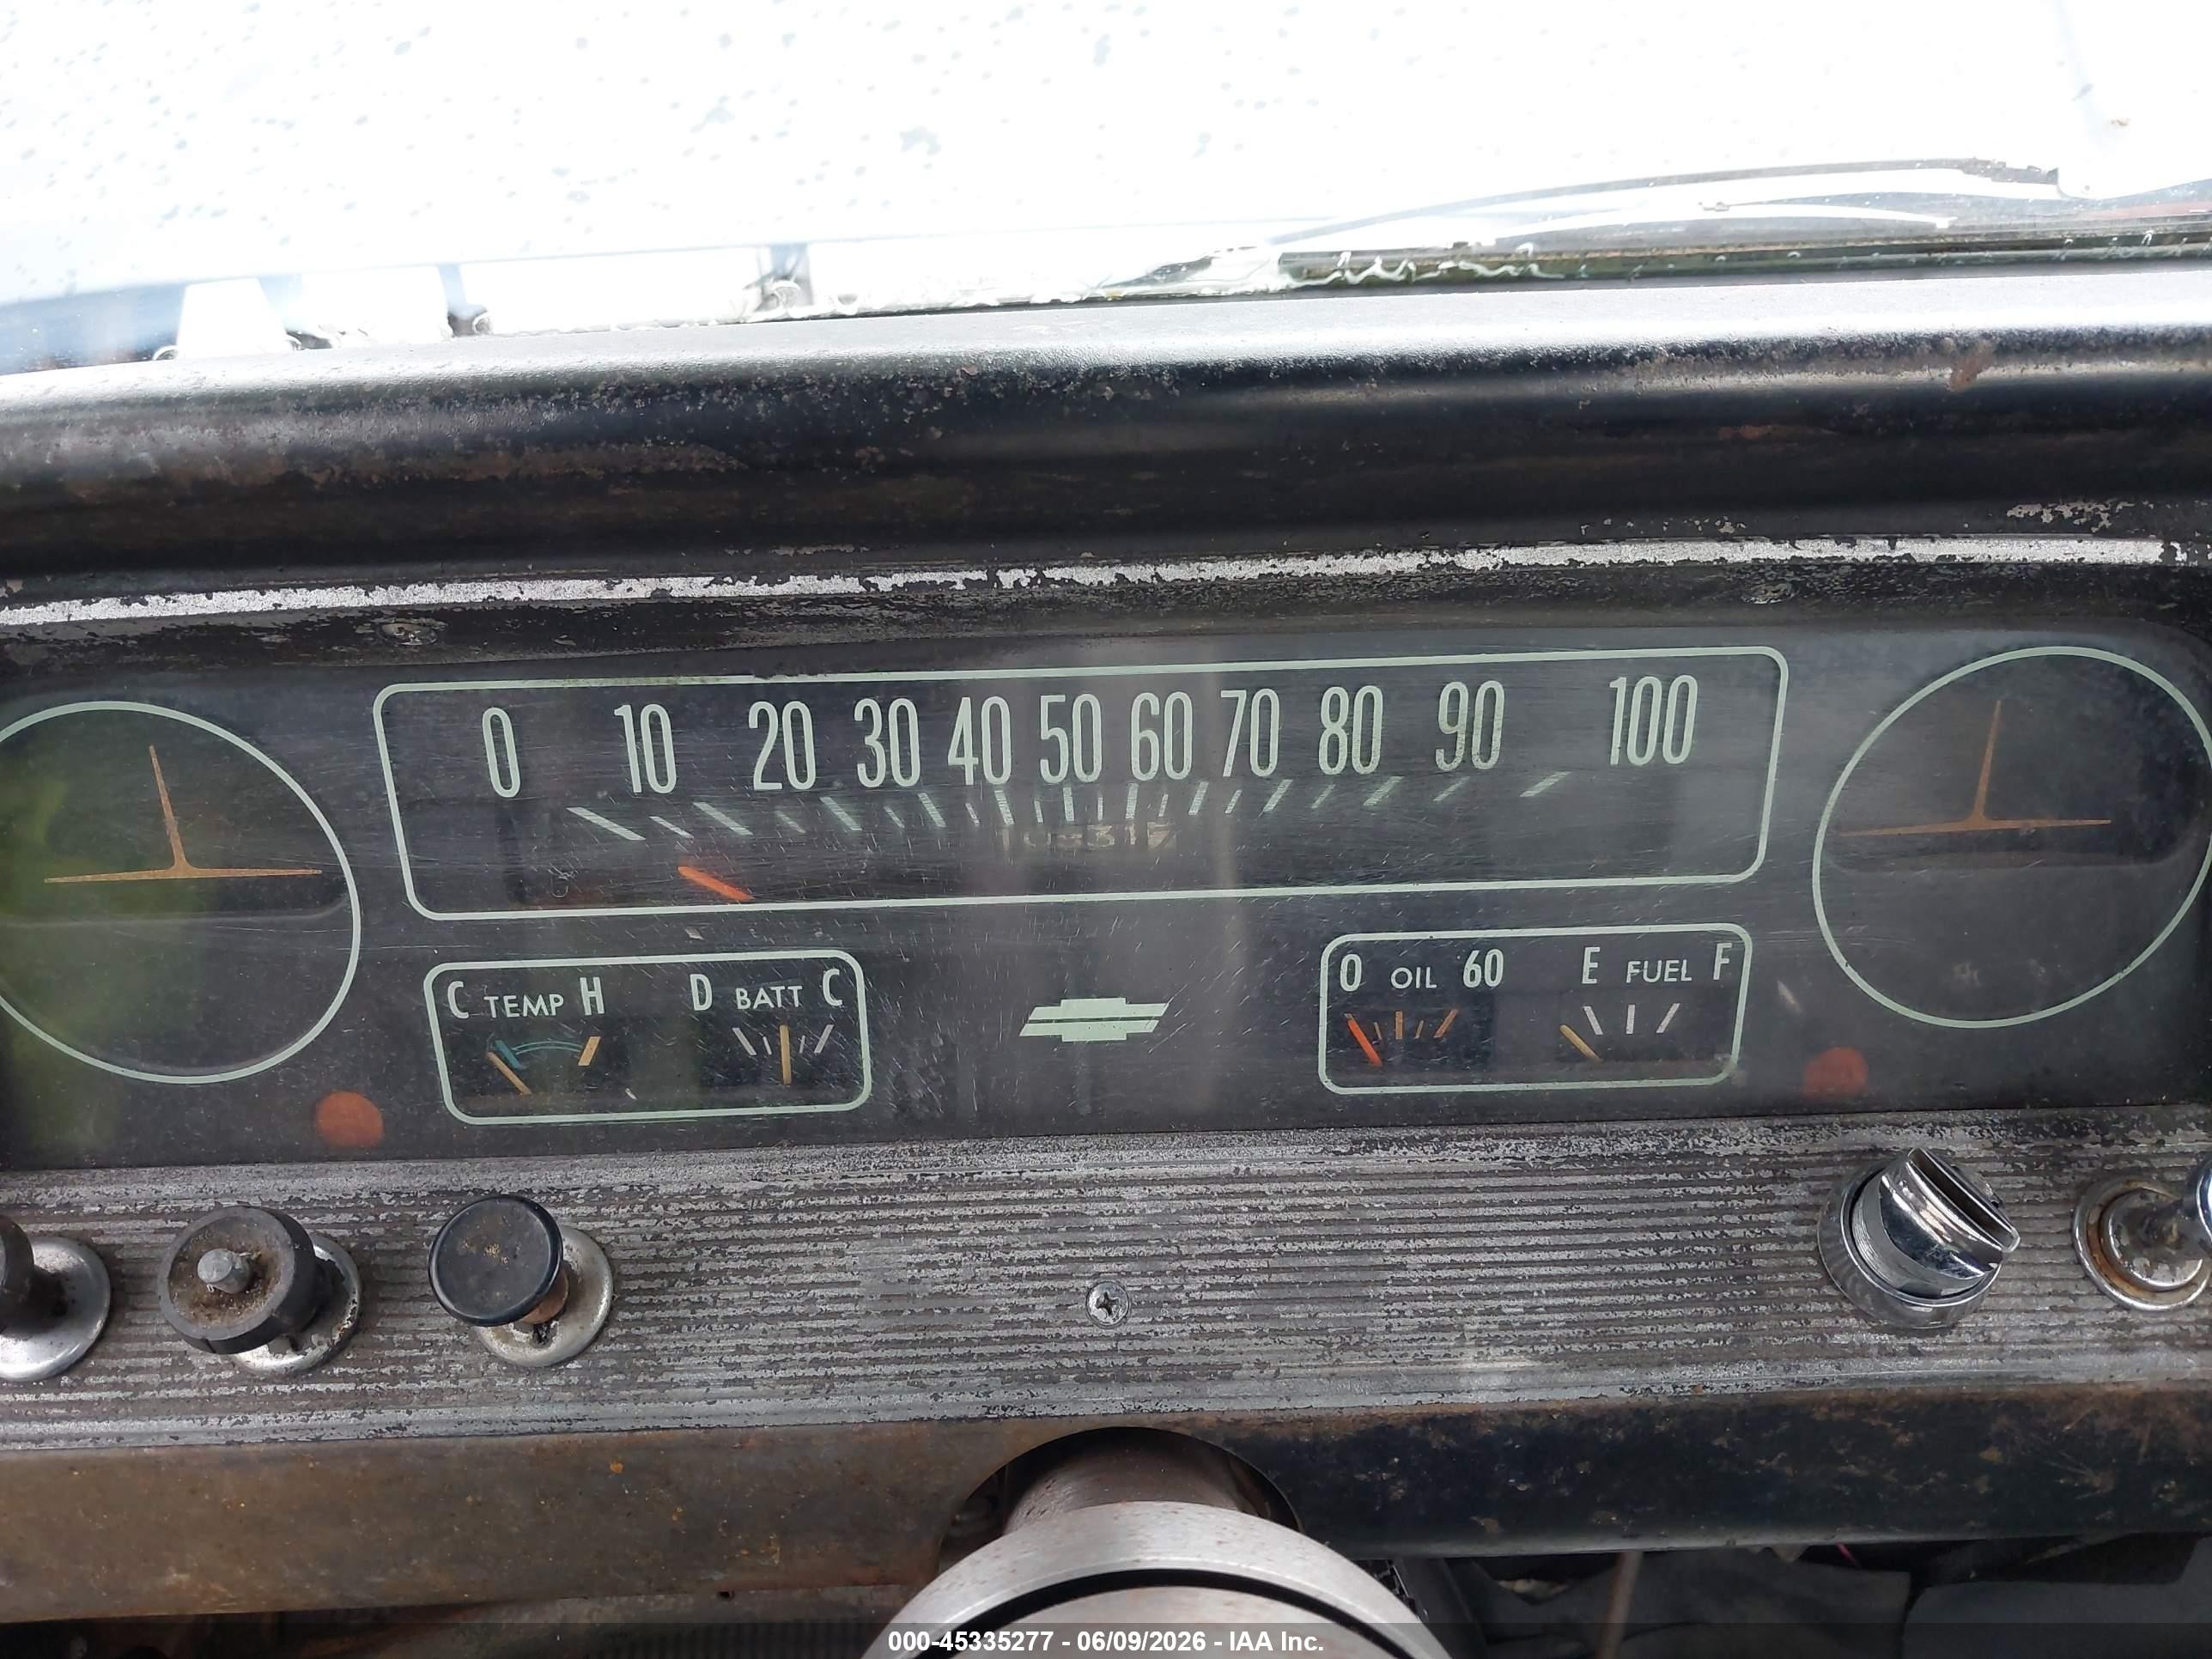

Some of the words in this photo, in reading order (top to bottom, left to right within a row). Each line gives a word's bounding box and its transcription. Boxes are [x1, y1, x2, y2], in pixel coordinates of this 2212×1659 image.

[482, 707, 521, 798] 0
[613, 703, 678, 794] 10
[748, 701, 817, 791] 20
[854, 697, 921, 788] 30
[947, 696, 1012, 786] 40
[1040, 693, 1103, 784] 50
[1130, 691, 1193, 781] 60
[1220, 688, 1280, 777] 70
[1318, 684, 1383, 775] 80
[1435, 680, 1505, 772] 90
[1609, 674, 1698, 766] 100
[1390, 966, 1437, 989] OIL
[1462, 948, 1504, 988] 60
[1582, 946, 1601, 984] E
[1626, 959, 1692, 983] FUEL
[1713, 942, 1733, 981] F
[447, 981, 470, 1019] C
[483, 994, 564, 1018] TEMP
[579, 976, 605, 1016] H
[689, 973, 713, 1012] D
[735, 985, 803, 1010] BATT
[822, 968, 843, 1008] C
